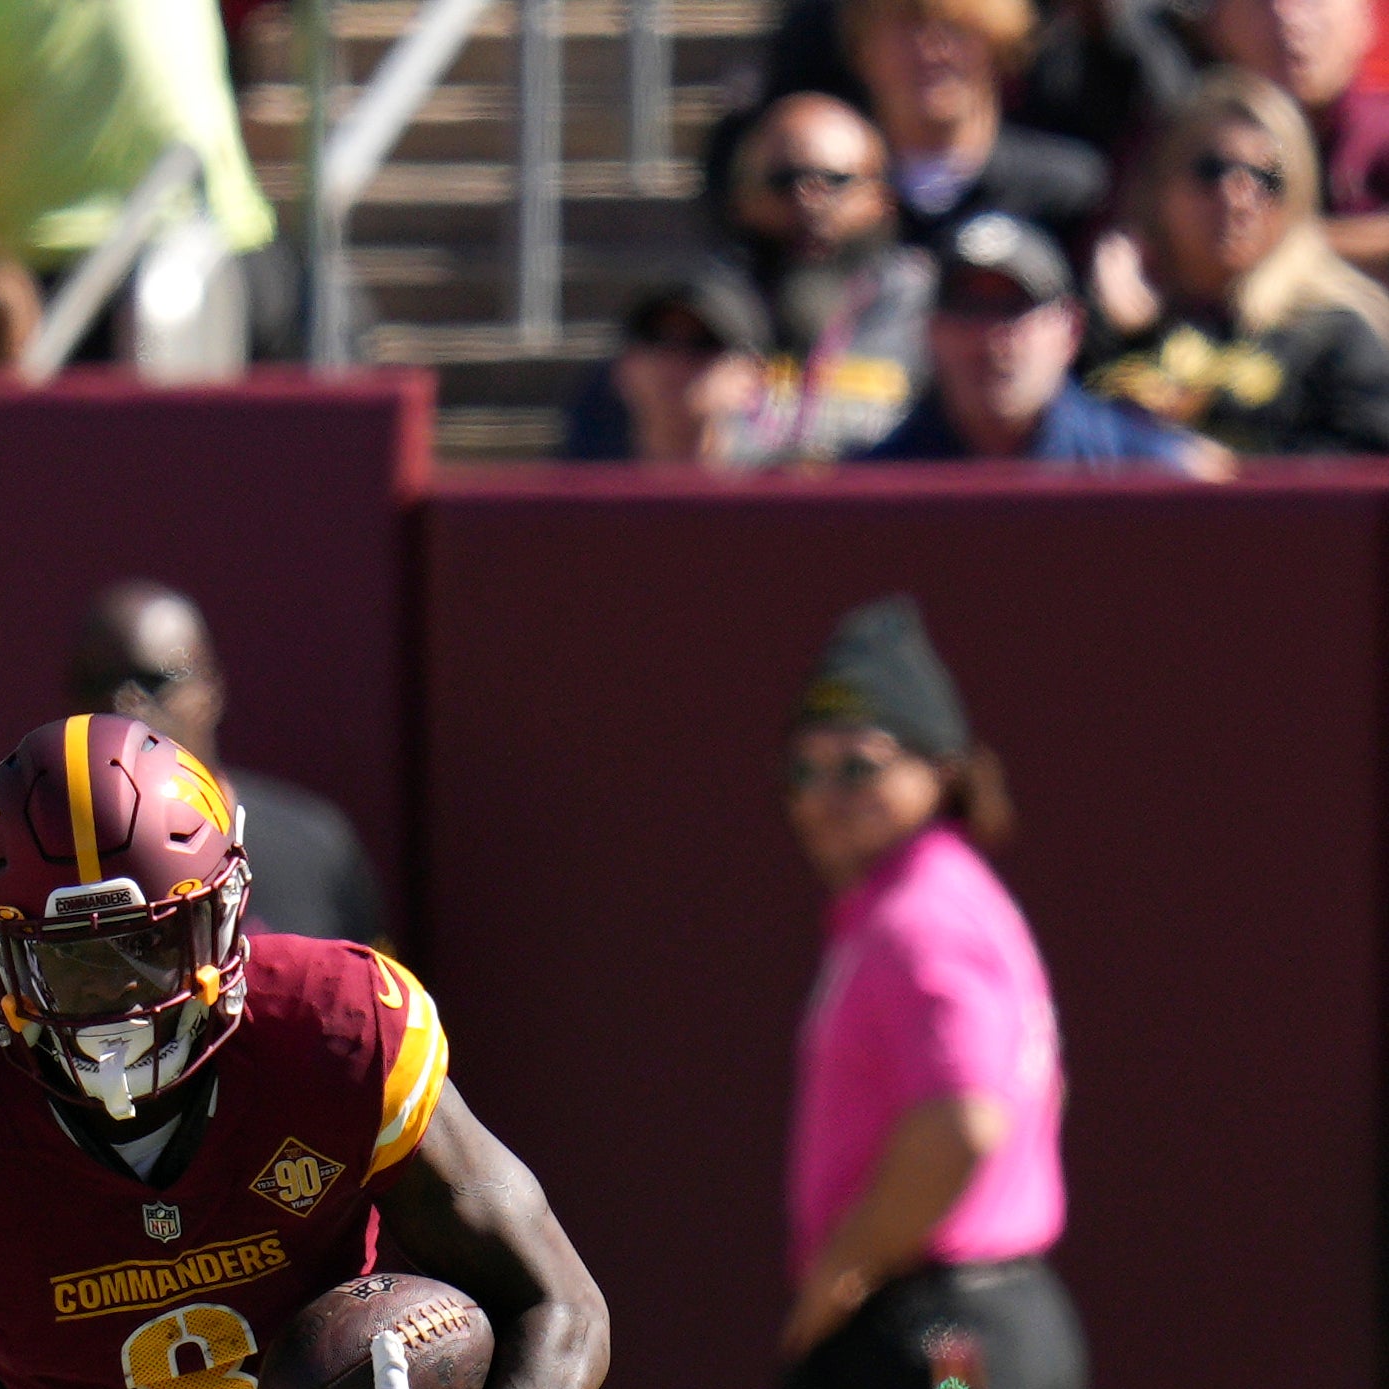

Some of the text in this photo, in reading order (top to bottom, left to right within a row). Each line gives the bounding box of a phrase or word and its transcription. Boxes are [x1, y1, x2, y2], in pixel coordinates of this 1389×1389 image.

[55, 891, 132, 913] COMMANDERS
[275, 1156, 323, 1202] 90
[149, 1219, 177, 1236] NFL
[54, 1238, 287, 1314] COMMANDERS
